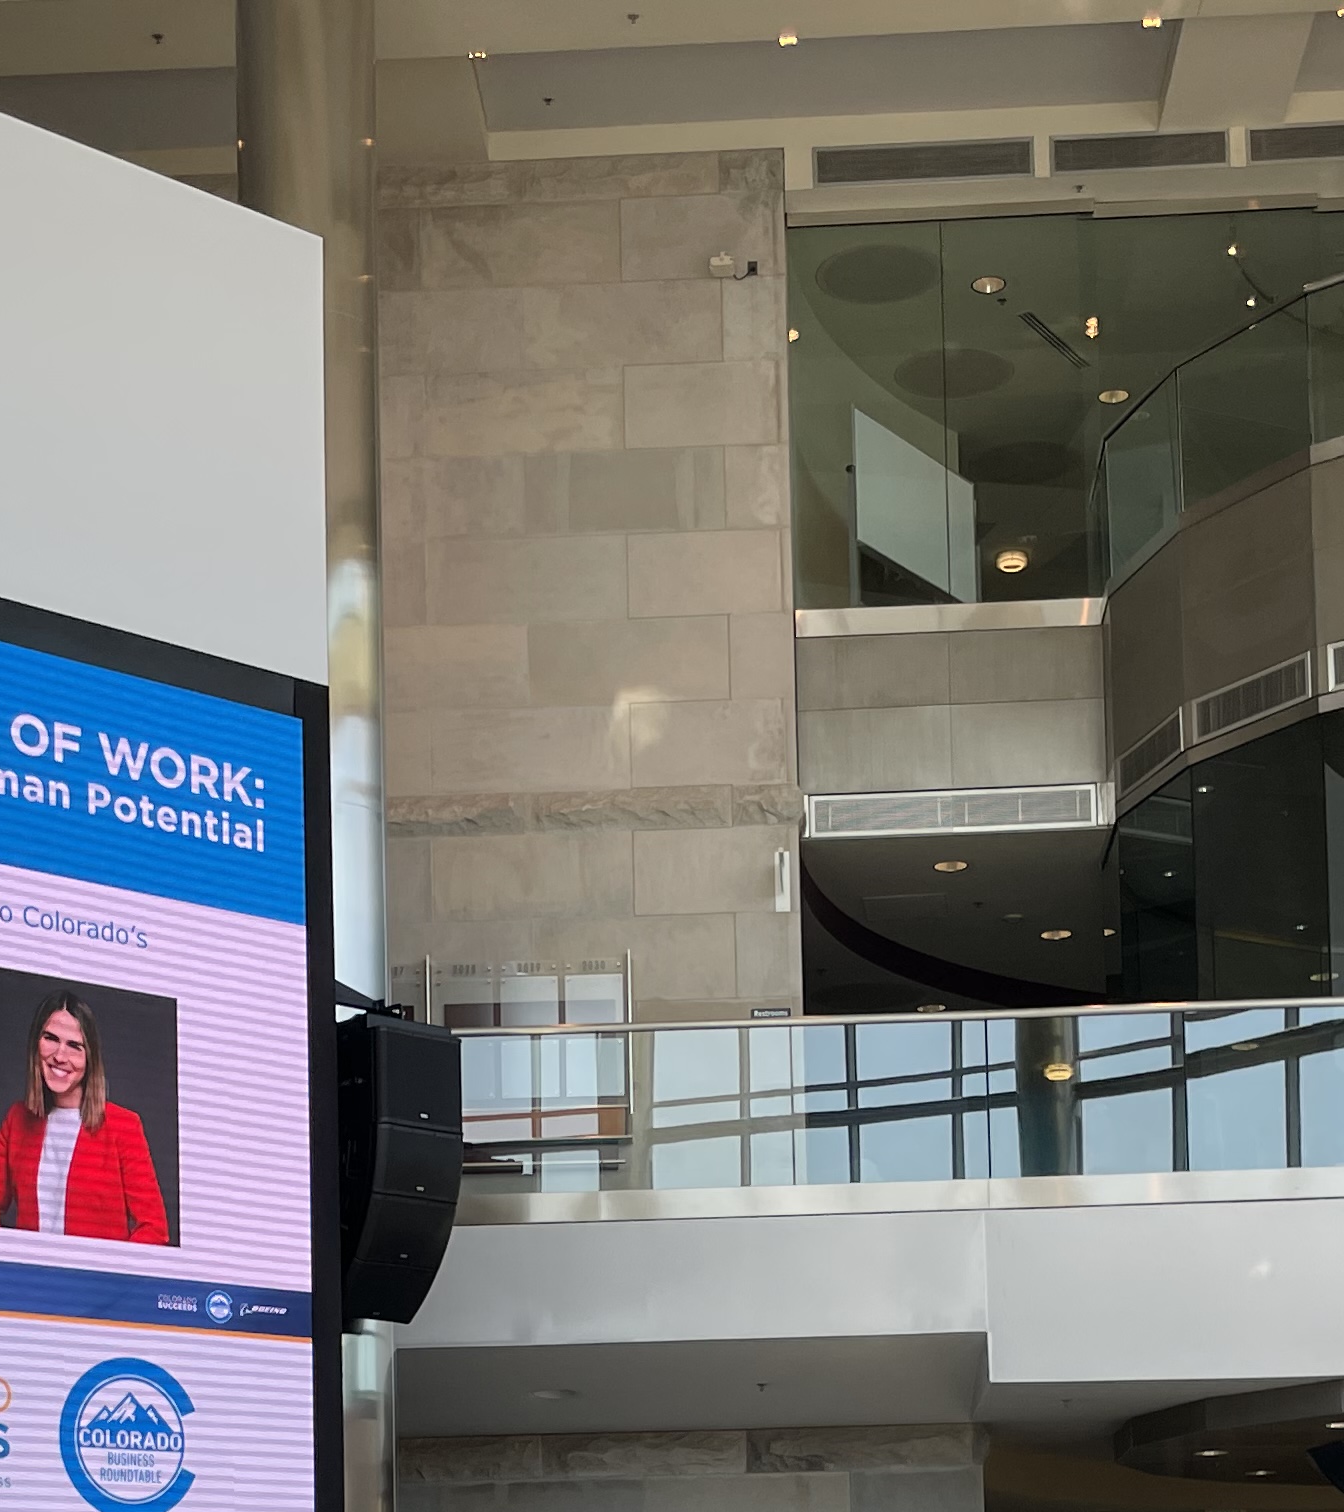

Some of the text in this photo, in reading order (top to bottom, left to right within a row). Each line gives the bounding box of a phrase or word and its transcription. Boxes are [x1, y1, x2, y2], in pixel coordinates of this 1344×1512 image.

[9, 713, 82, 763] OF
[98, 731, 265, 809] WORK:
[87, 782, 264, 853] Potential
[23, 905, 148, 949] Colorado's
[79, 1428, 182, 1451] COLORADO
[100, 1468, 162, 1484] ROUNDTABLE
[107, 1452, 155, 1468] BUSINESS
